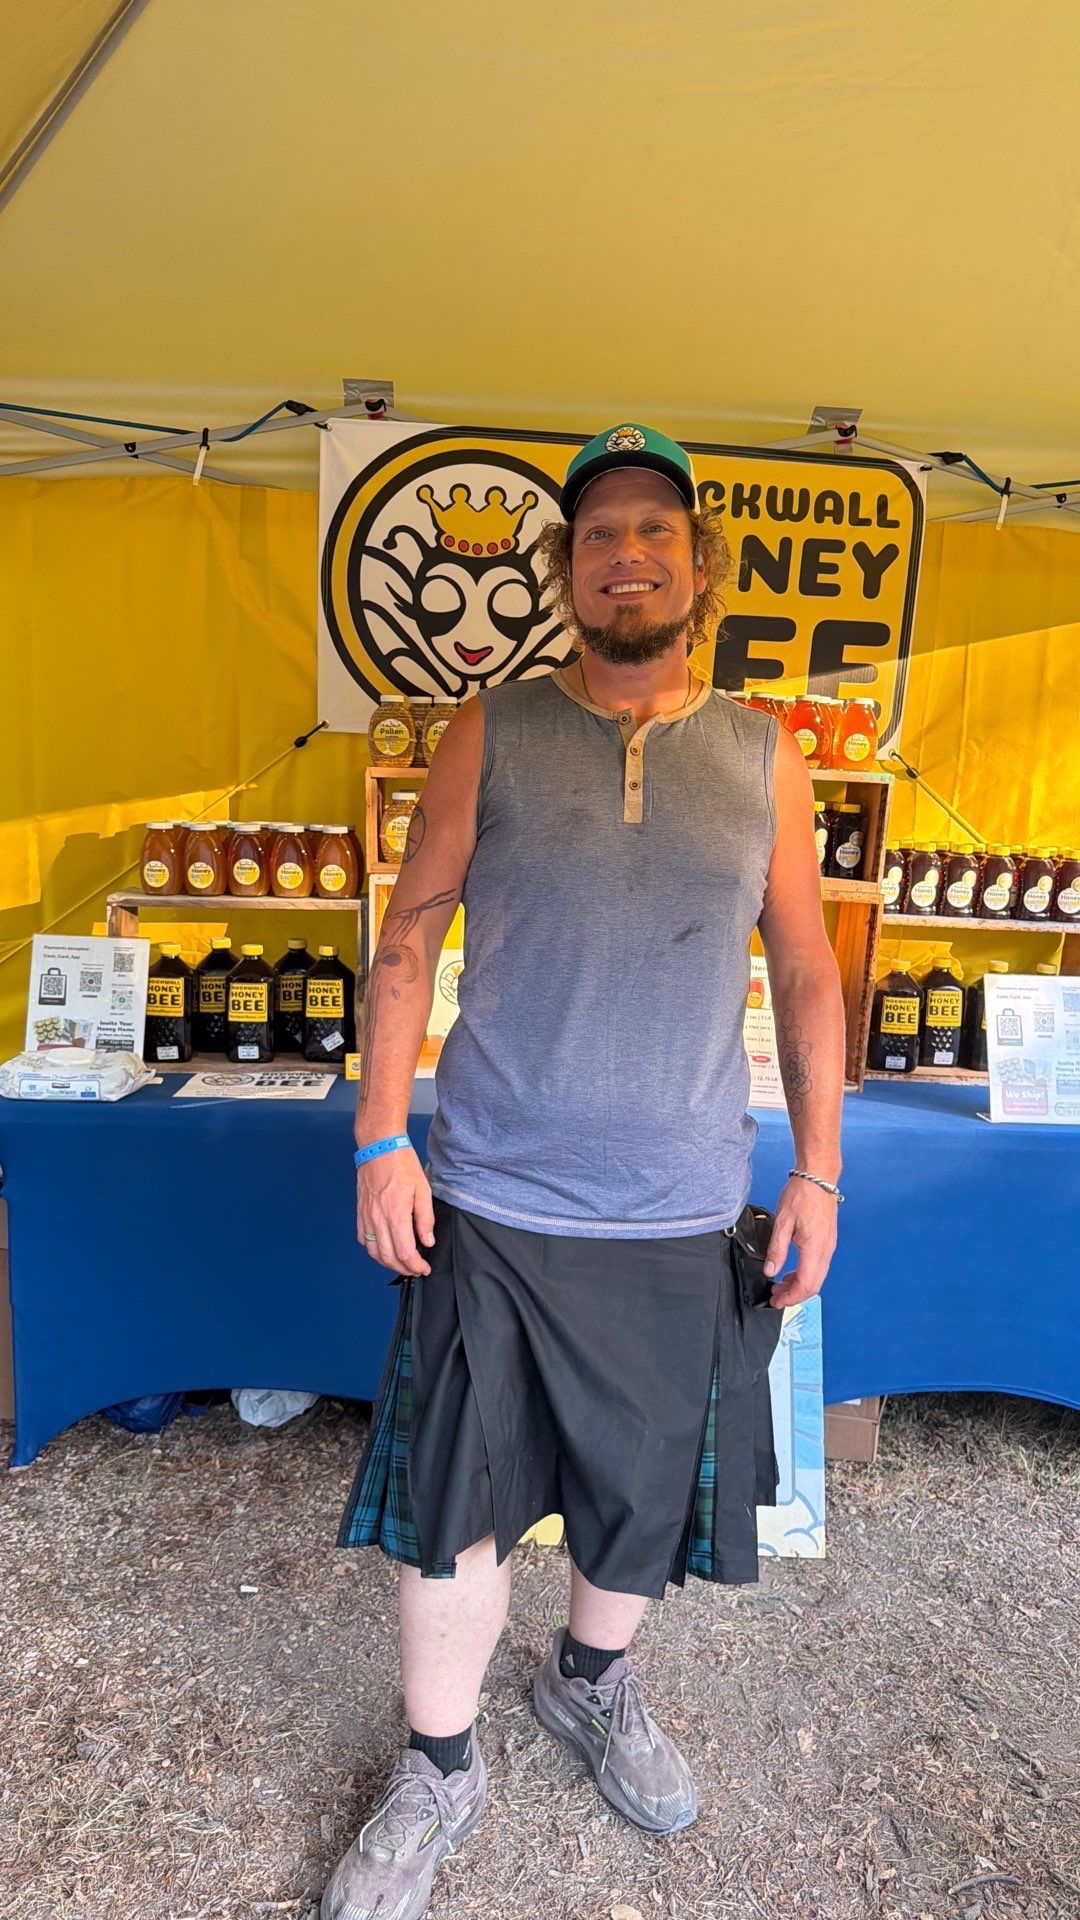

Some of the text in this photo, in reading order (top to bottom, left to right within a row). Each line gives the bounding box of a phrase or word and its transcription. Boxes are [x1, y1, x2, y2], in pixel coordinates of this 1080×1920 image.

[697, 480, 900, 528] CKWALL
[738, 534, 899, 599] NEY
[147, 993, 180, 1005] BEE
[202, 992, 224, 1002] BE
[283, 990, 303, 1000] BE
[232, 1000, 264, 1011] BEE
[309, 996, 341, 1006] BEE
[929, 1006, 959, 1016] BEE
[885, 1012, 916, 1024] BEE
[1006, 1089, 1020, 1099] We
